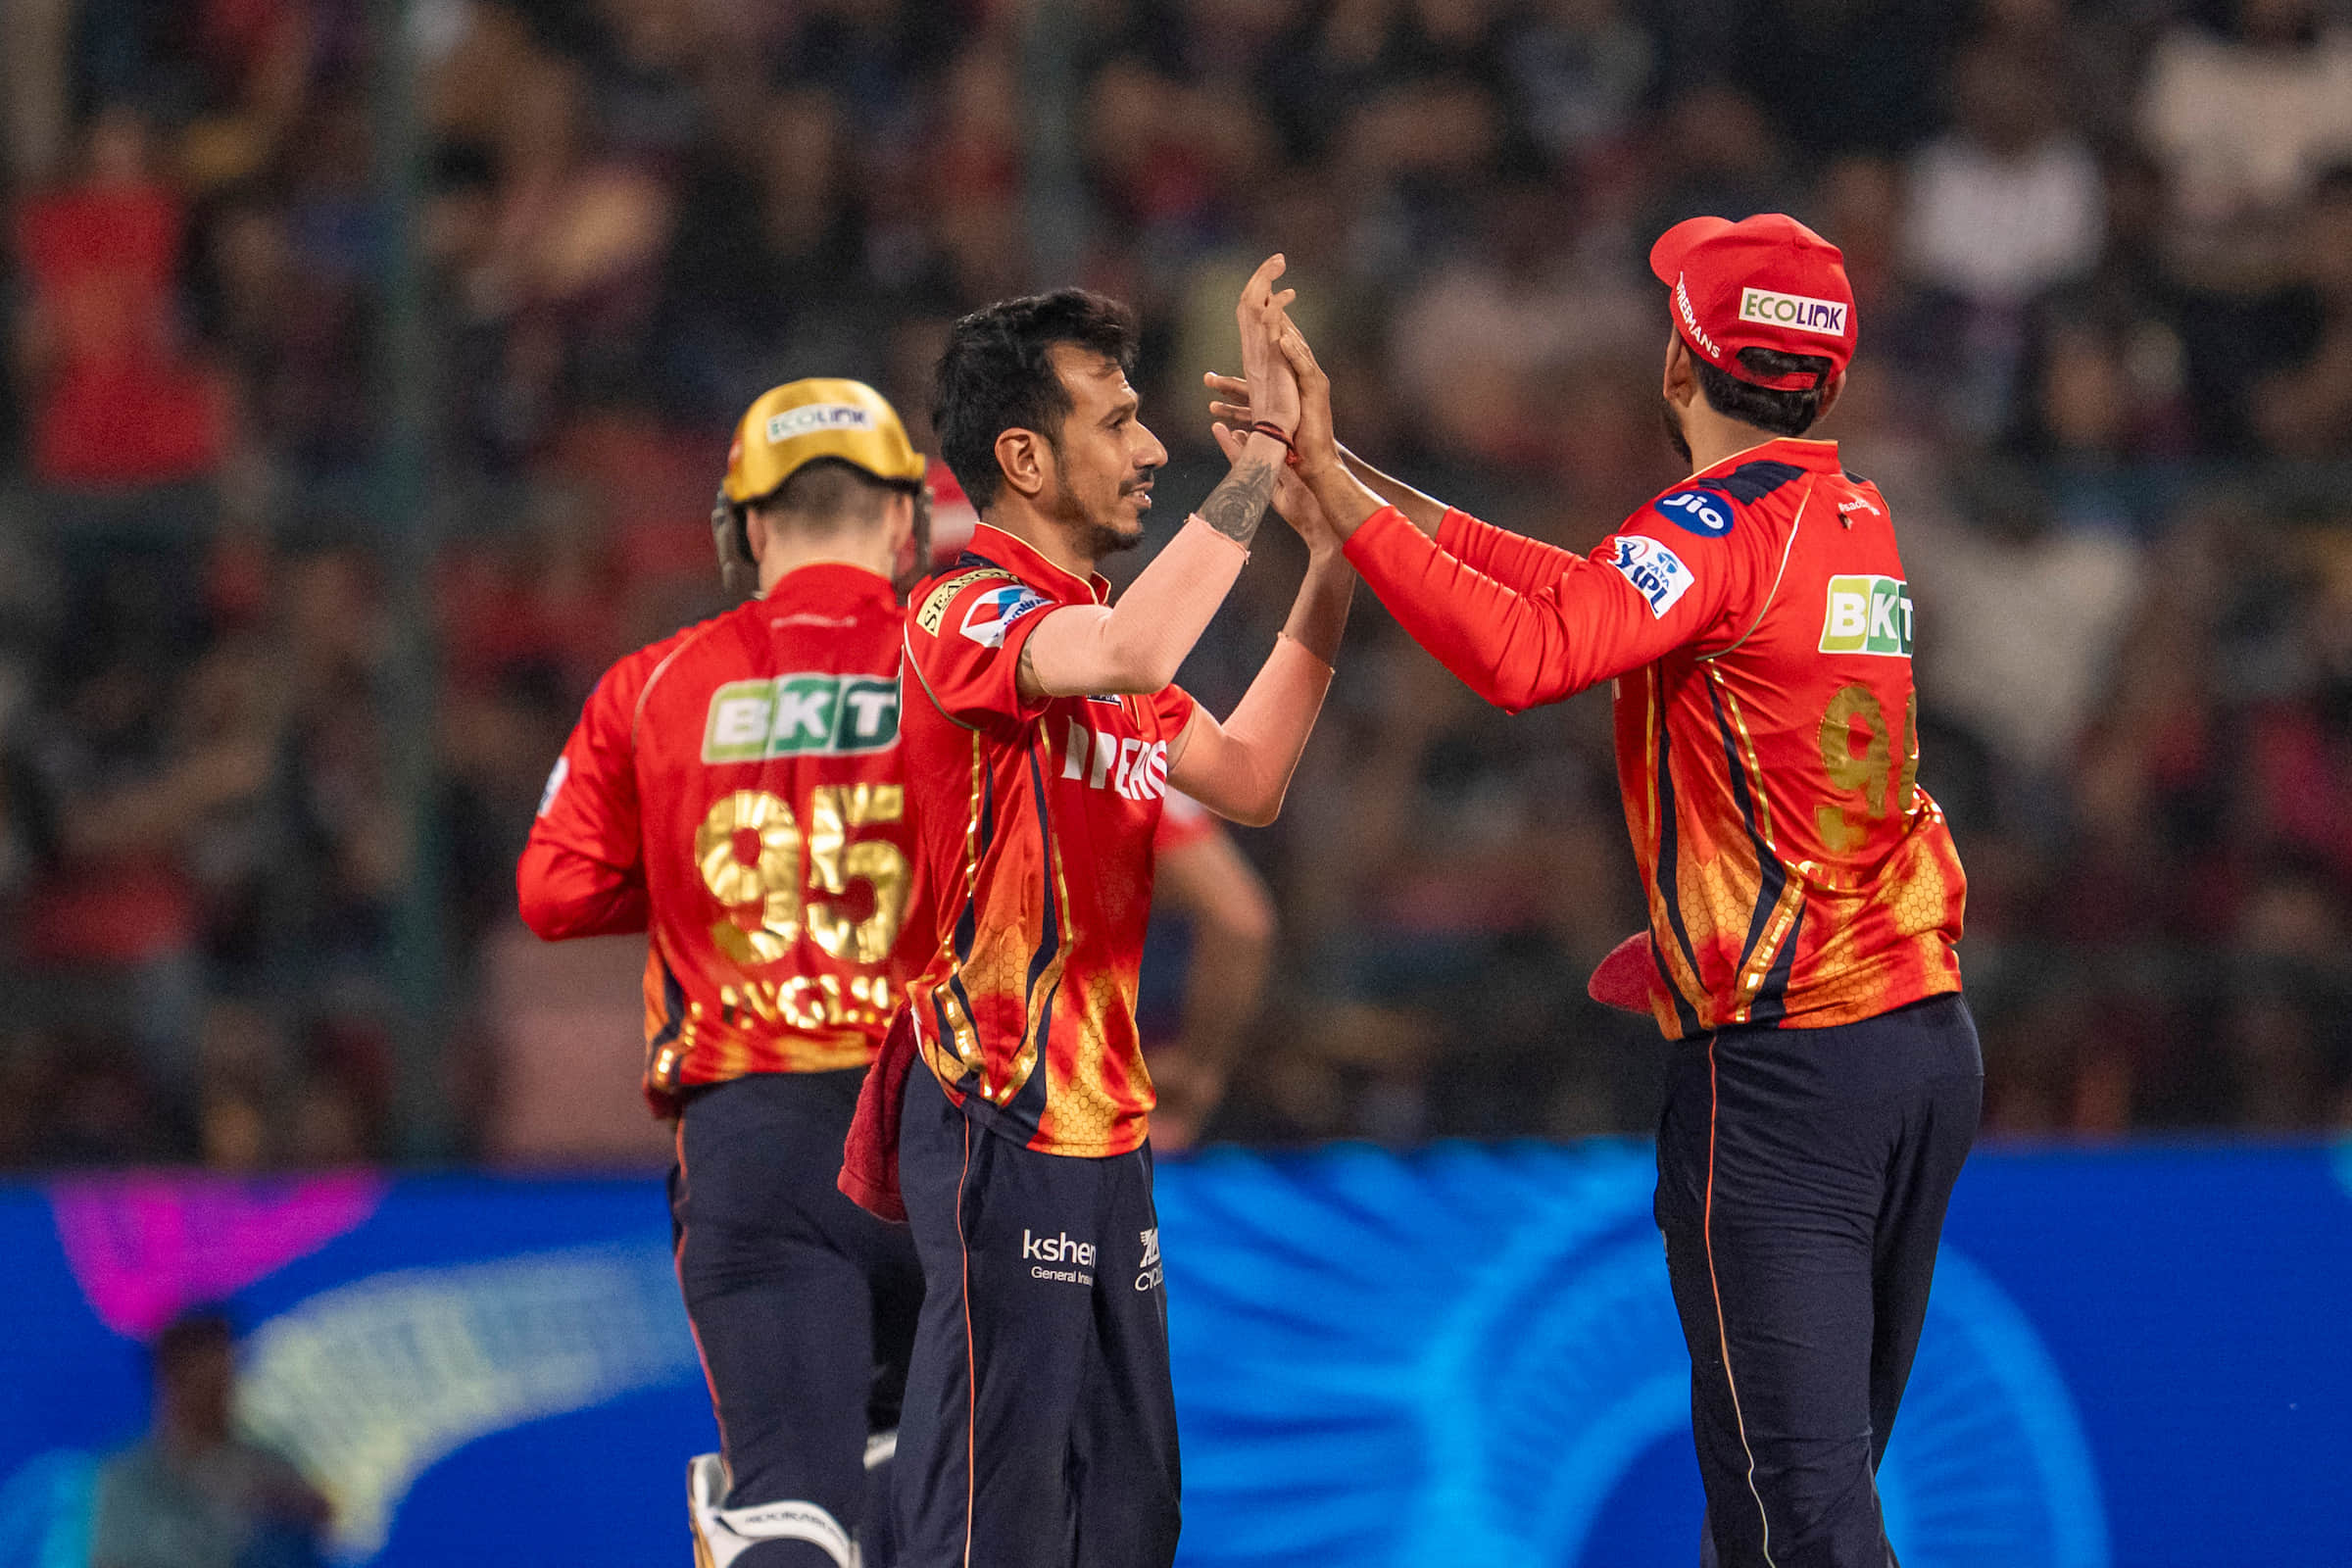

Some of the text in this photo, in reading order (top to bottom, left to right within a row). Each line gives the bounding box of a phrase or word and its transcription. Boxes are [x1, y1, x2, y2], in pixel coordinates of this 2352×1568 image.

[1744, 293, 1842, 330] ECOLINK
[1662, 494, 1724, 529] Jio
[1631, 564, 1668, 614] IPL
[1830, 592, 1914, 642] BKT
[712, 689, 897, 746] BKT
[695, 782, 913, 964] 95
[1031, 1265, 1077, 1283] General
